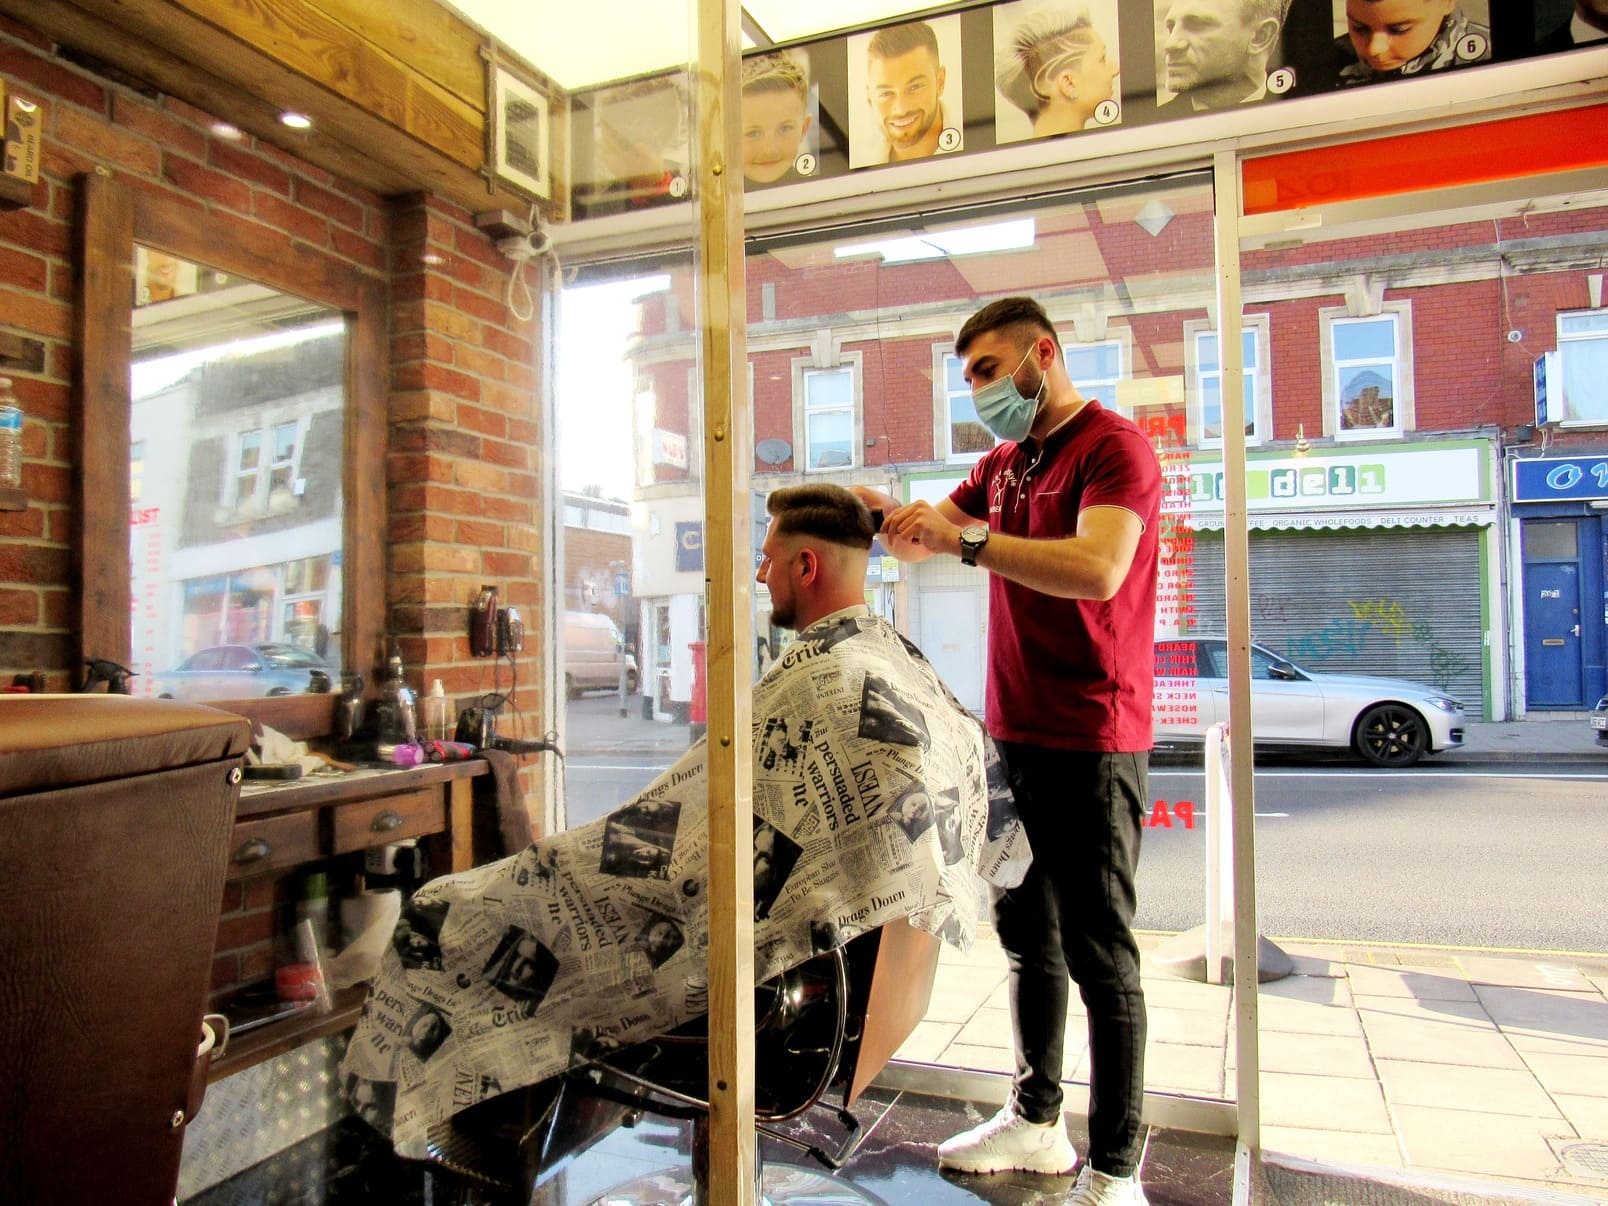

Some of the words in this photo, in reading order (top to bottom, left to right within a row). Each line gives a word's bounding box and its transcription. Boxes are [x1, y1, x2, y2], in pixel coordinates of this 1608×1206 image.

[1272, 519, 1312, 527] ORGANIC
[1314, 517, 1372, 526] WHOLEFOODS
[1380, 517, 1401, 525] DELI
[1403, 516, 1444, 524] COUNTER
[670, 762, 704, 786] Down
[806, 759, 840, 831] warriors
[813, 738, 860, 827] persuaded
[559, 885, 592, 952] warriors
[838, 905, 872, 928] Drags
[871, 890, 906, 911] Down
